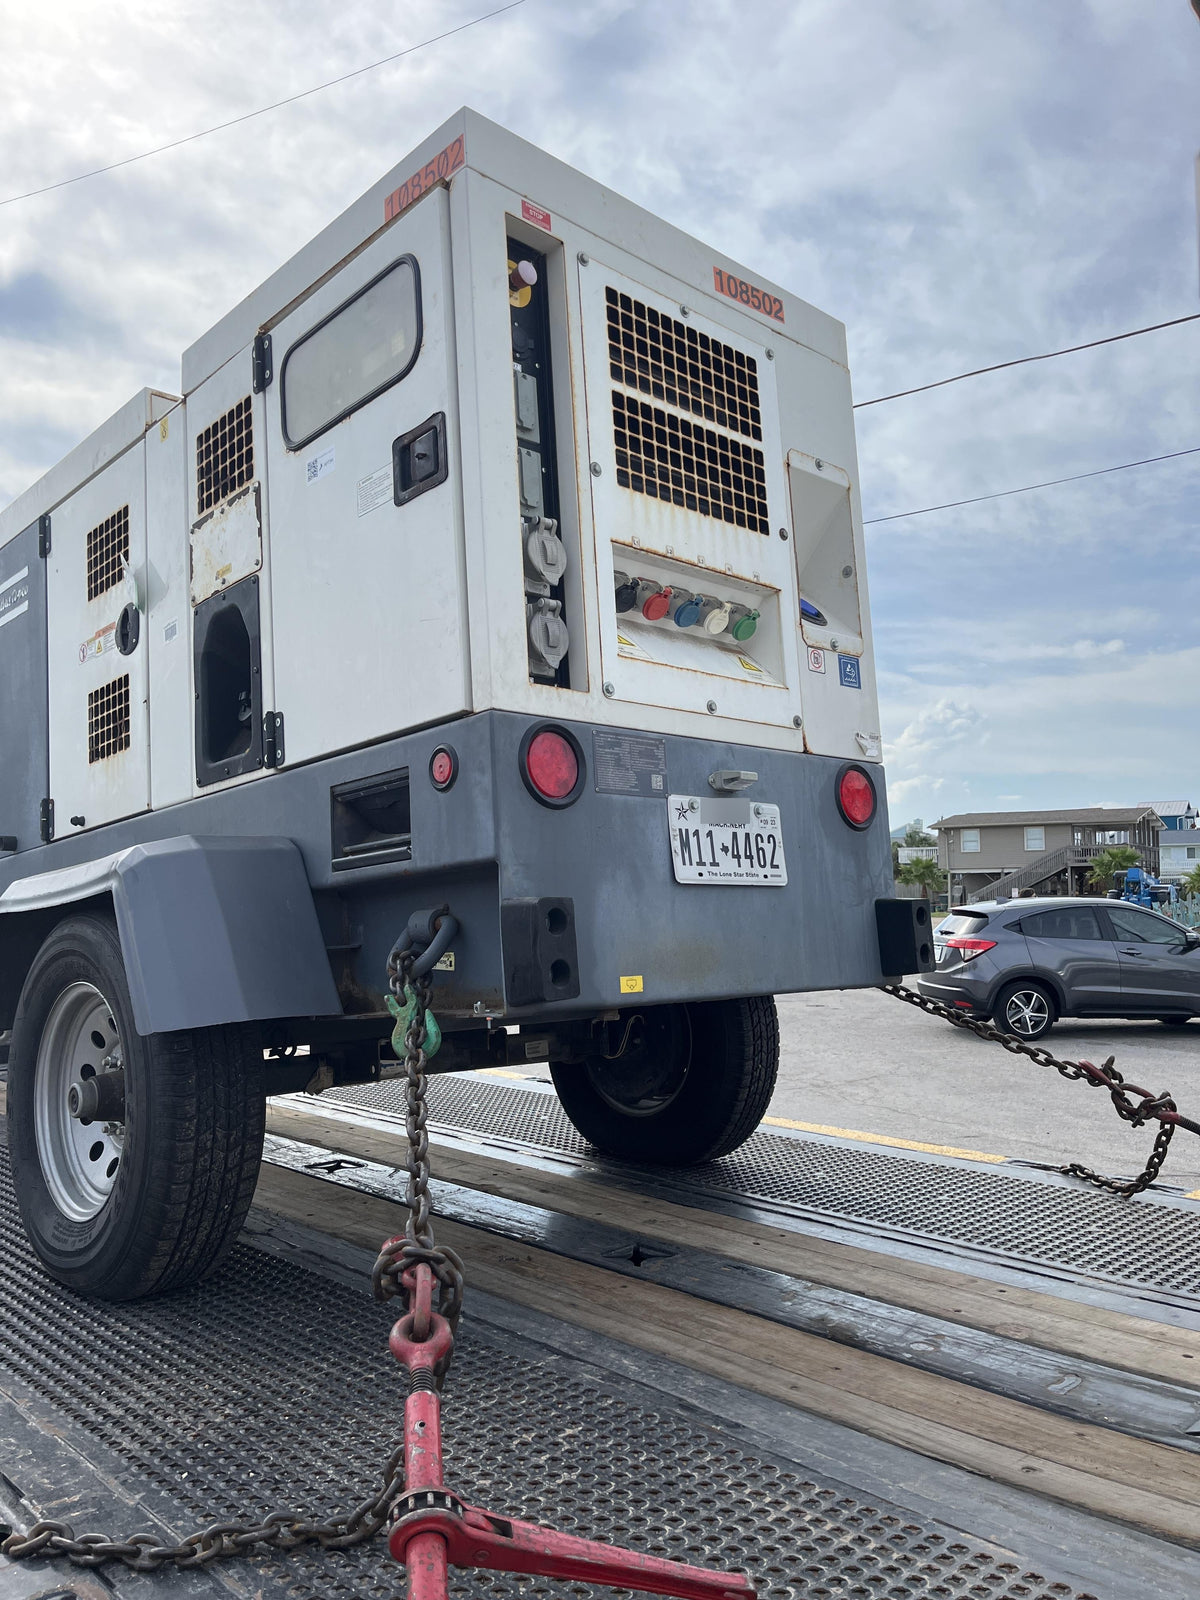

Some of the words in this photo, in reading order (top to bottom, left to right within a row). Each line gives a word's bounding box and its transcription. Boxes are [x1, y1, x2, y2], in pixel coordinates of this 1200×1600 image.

[387, 137, 463, 216] 108502
[529, 209, 544, 220] STOP
[716, 269, 784, 322] 108502
[678, 828, 720, 868] M11
[731, 831, 780, 870] 4462
